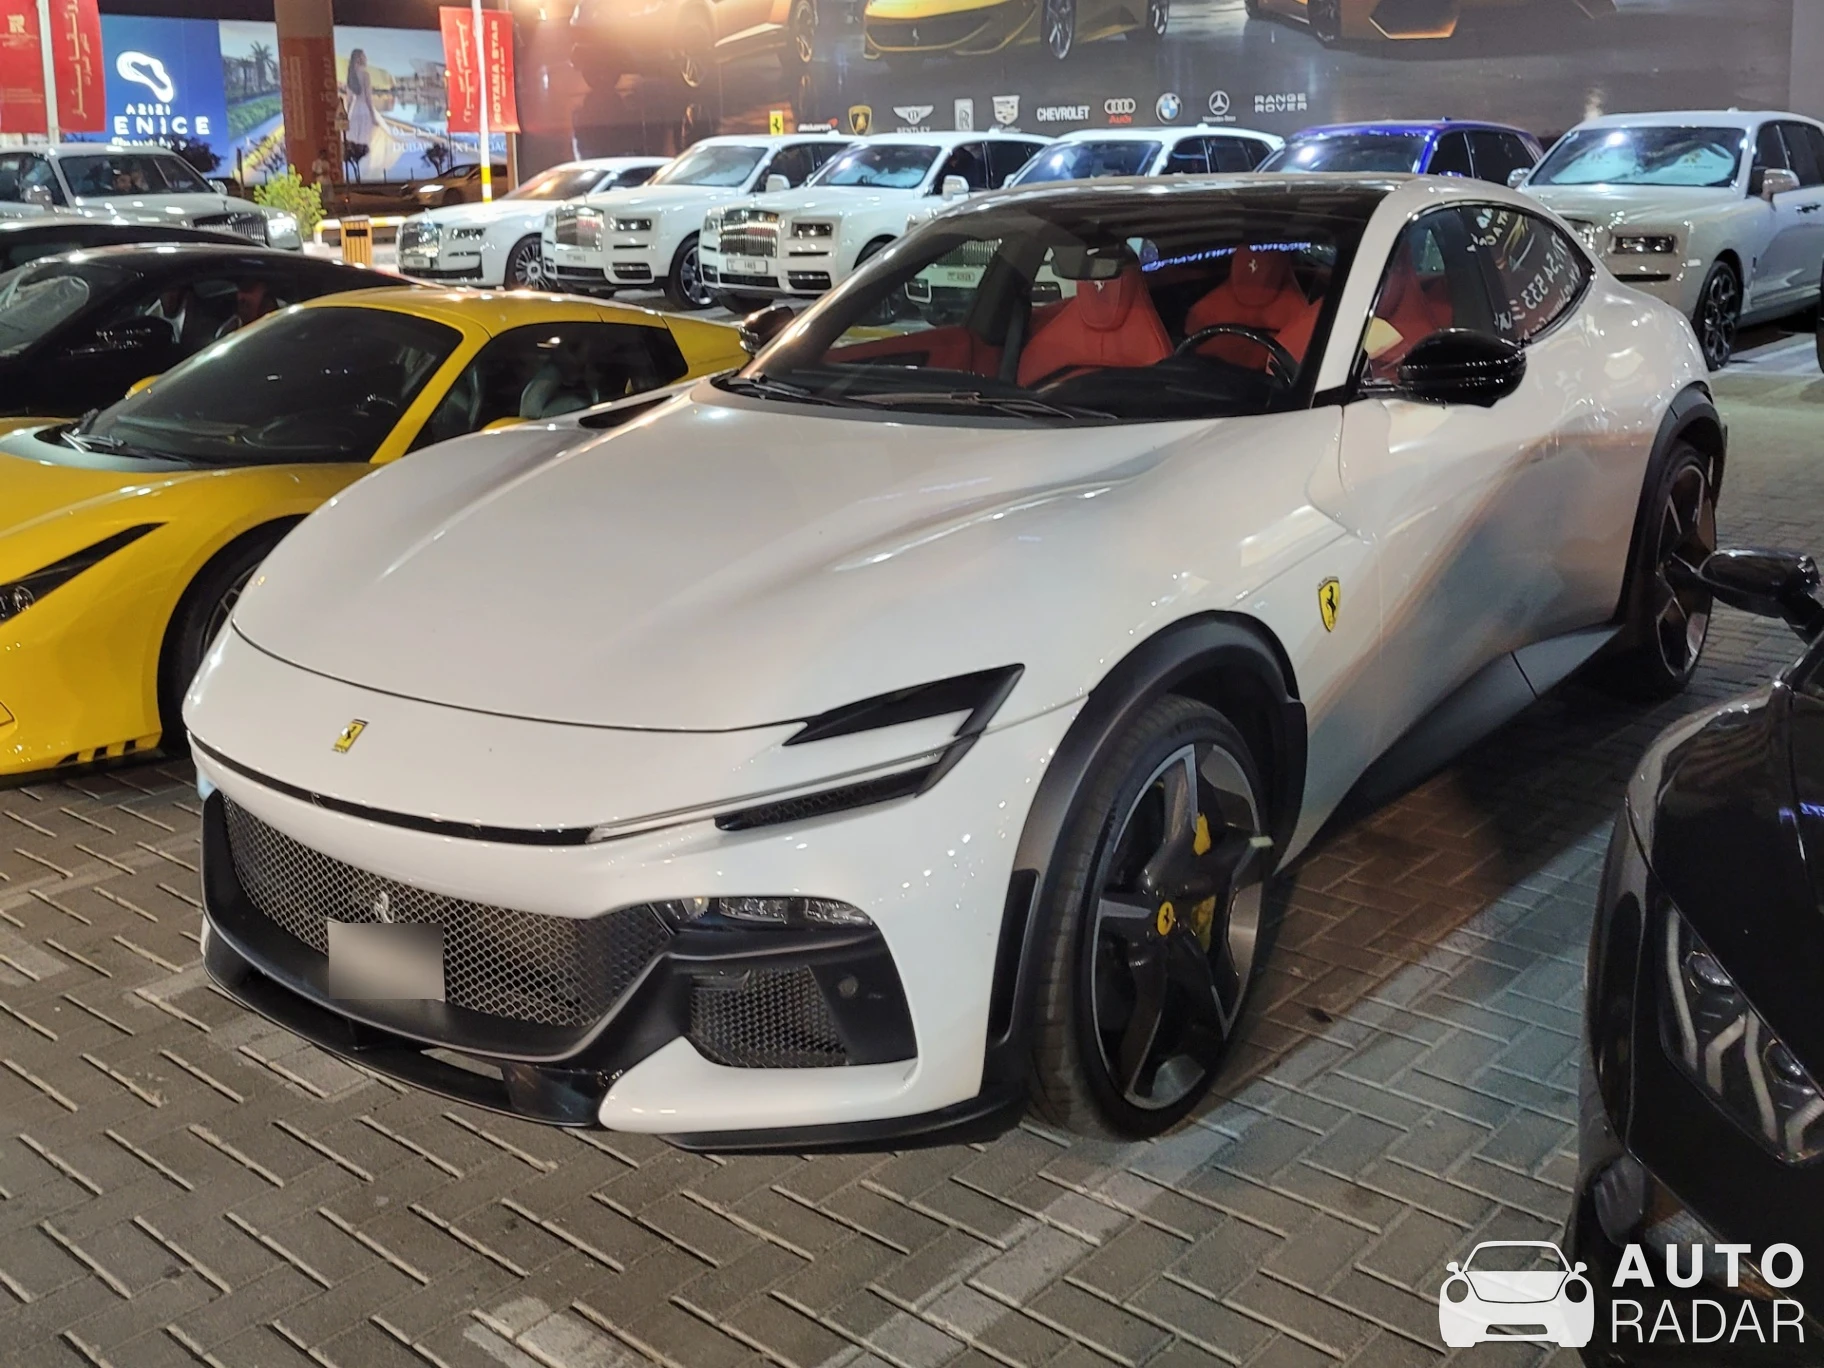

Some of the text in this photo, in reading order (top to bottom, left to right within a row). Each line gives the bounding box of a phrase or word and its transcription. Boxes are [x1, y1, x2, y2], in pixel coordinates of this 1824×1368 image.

[491, 20, 502, 124] ROTANA STAR
[1254, 93, 1307, 104] RANGE
[1036, 105, 1090, 122] CHEVROLET
[1254, 104, 1308, 114] ROVER
[1109, 114, 1133, 124] Audi
